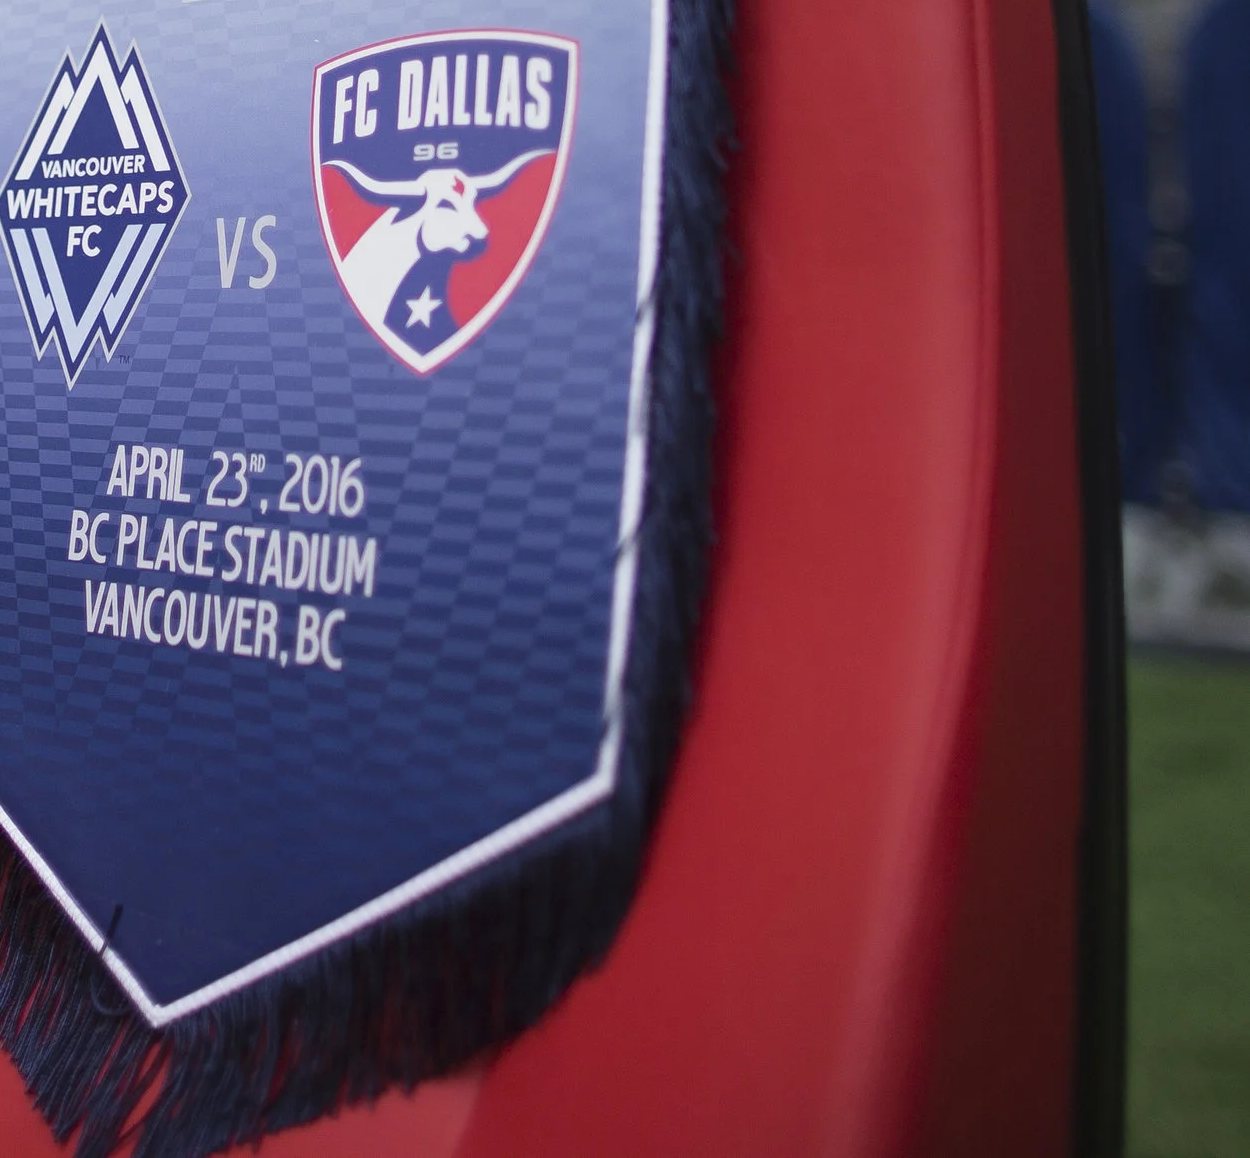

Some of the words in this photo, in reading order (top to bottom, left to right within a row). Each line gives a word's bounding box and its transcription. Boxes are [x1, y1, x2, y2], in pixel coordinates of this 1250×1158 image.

[333, 68, 380, 145] FC
[397, 53, 553, 131] DALLAS
[41, 154, 146, 179] VANCOUVER
[413, 142, 459, 162] 96
[6, 180, 175, 220] WHITECAPS
[66, 225, 102, 258] FC
[216, 214, 278, 290] VS
[106, 444, 191, 503] APRIL
[279, 453, 364, 517] 2016
[68, 509, 110, 563] BC
[116, 514, 218, 577] PLACE
[221, 525, 377, 597] STADIUM
[85, 579, 288, 668] VANCOUVER,
[296, 604, 346, 671] BC
